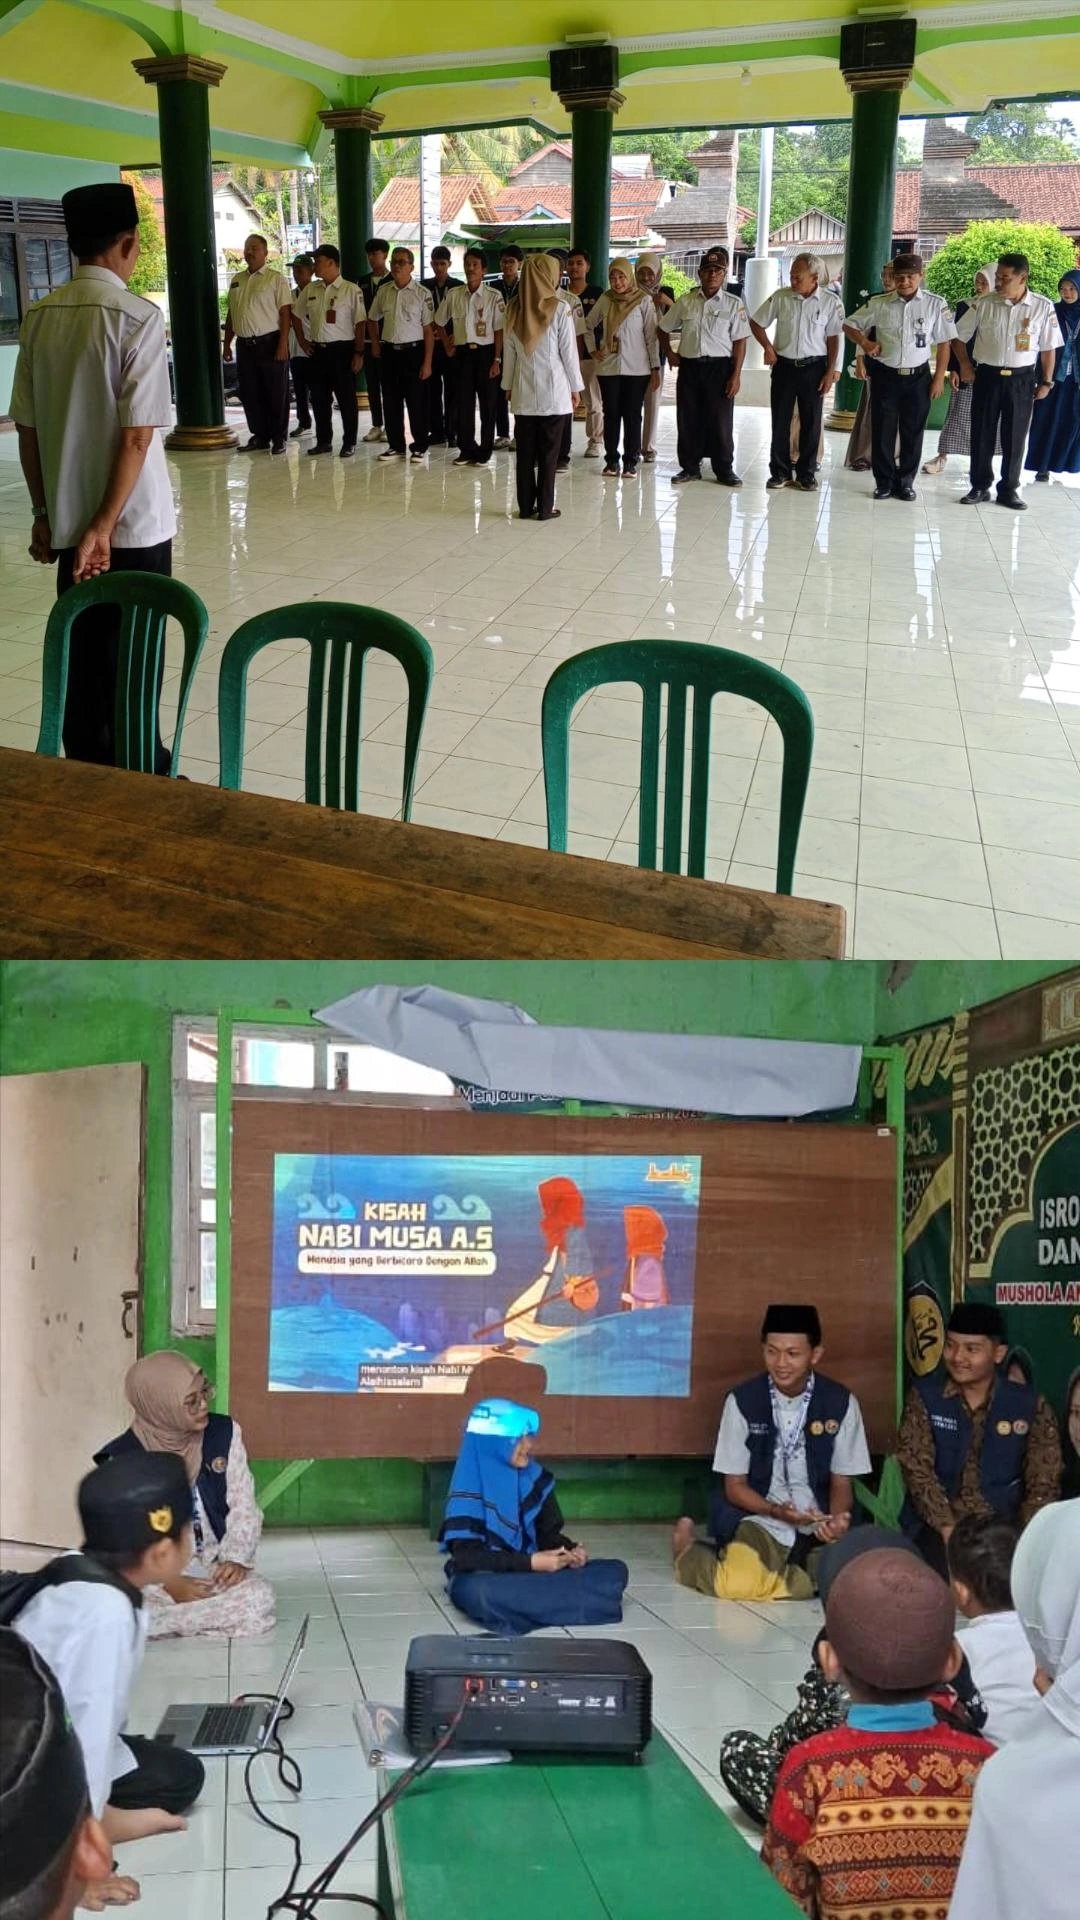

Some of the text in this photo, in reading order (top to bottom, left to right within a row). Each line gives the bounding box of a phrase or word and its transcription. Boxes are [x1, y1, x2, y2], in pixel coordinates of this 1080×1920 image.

[364, 1202, 427, 1221] KISAH
[299, 1224, 493, 1249] NABI MUSA A.S
[307, 1255, 346, 1265] Manusia
[349, 1257, 373, 1267] yang
[376, 1255, 423, 1266] Berbicara
[464, 1256, 489, 1266] Allah
[997, 1282, 1064, 1304] MUSHOLA
[360, 1364, 409, 1374] menonton
[410, 1364, 436, 1375] kisah
[438, 1365, 460, 1375] Nabi
